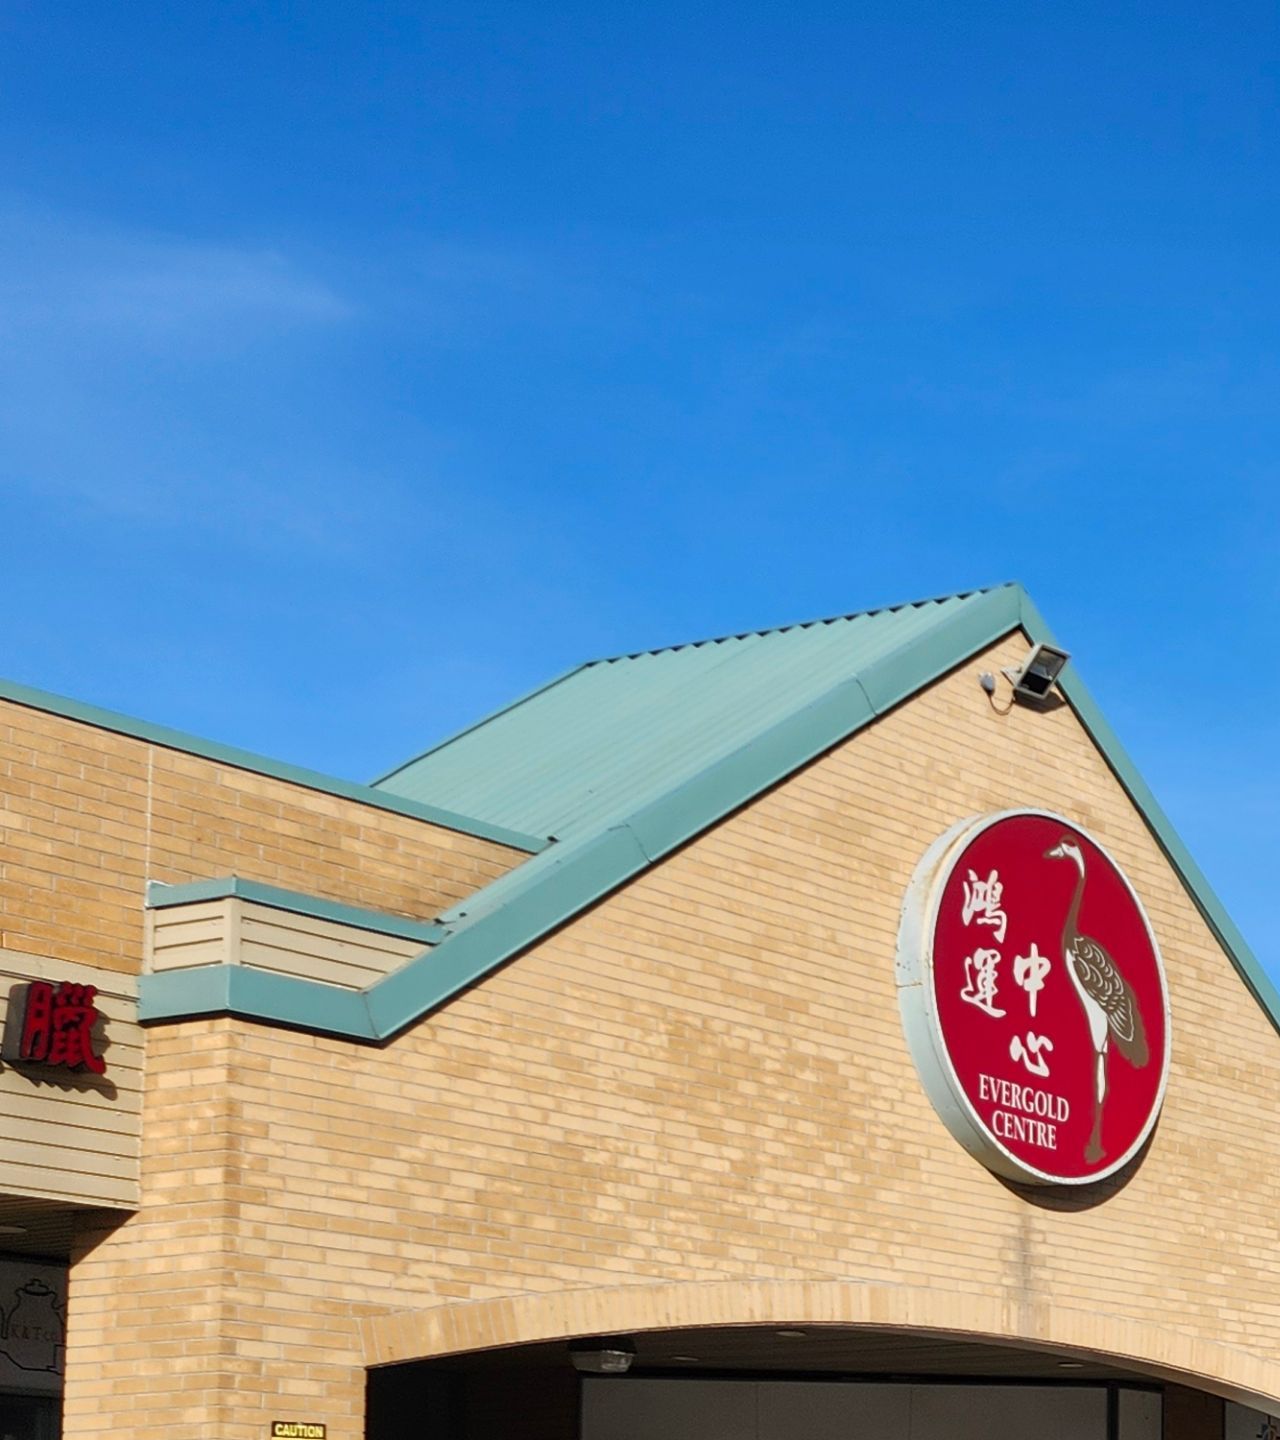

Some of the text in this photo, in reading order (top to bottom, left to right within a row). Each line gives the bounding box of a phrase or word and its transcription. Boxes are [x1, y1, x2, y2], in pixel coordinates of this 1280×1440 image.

[979, 1074, 1070, 1122] EVERGOLD
[992, 1110, 1057, 1149] CENTRE
[275, 1424, 324, 1438] CAUTION
